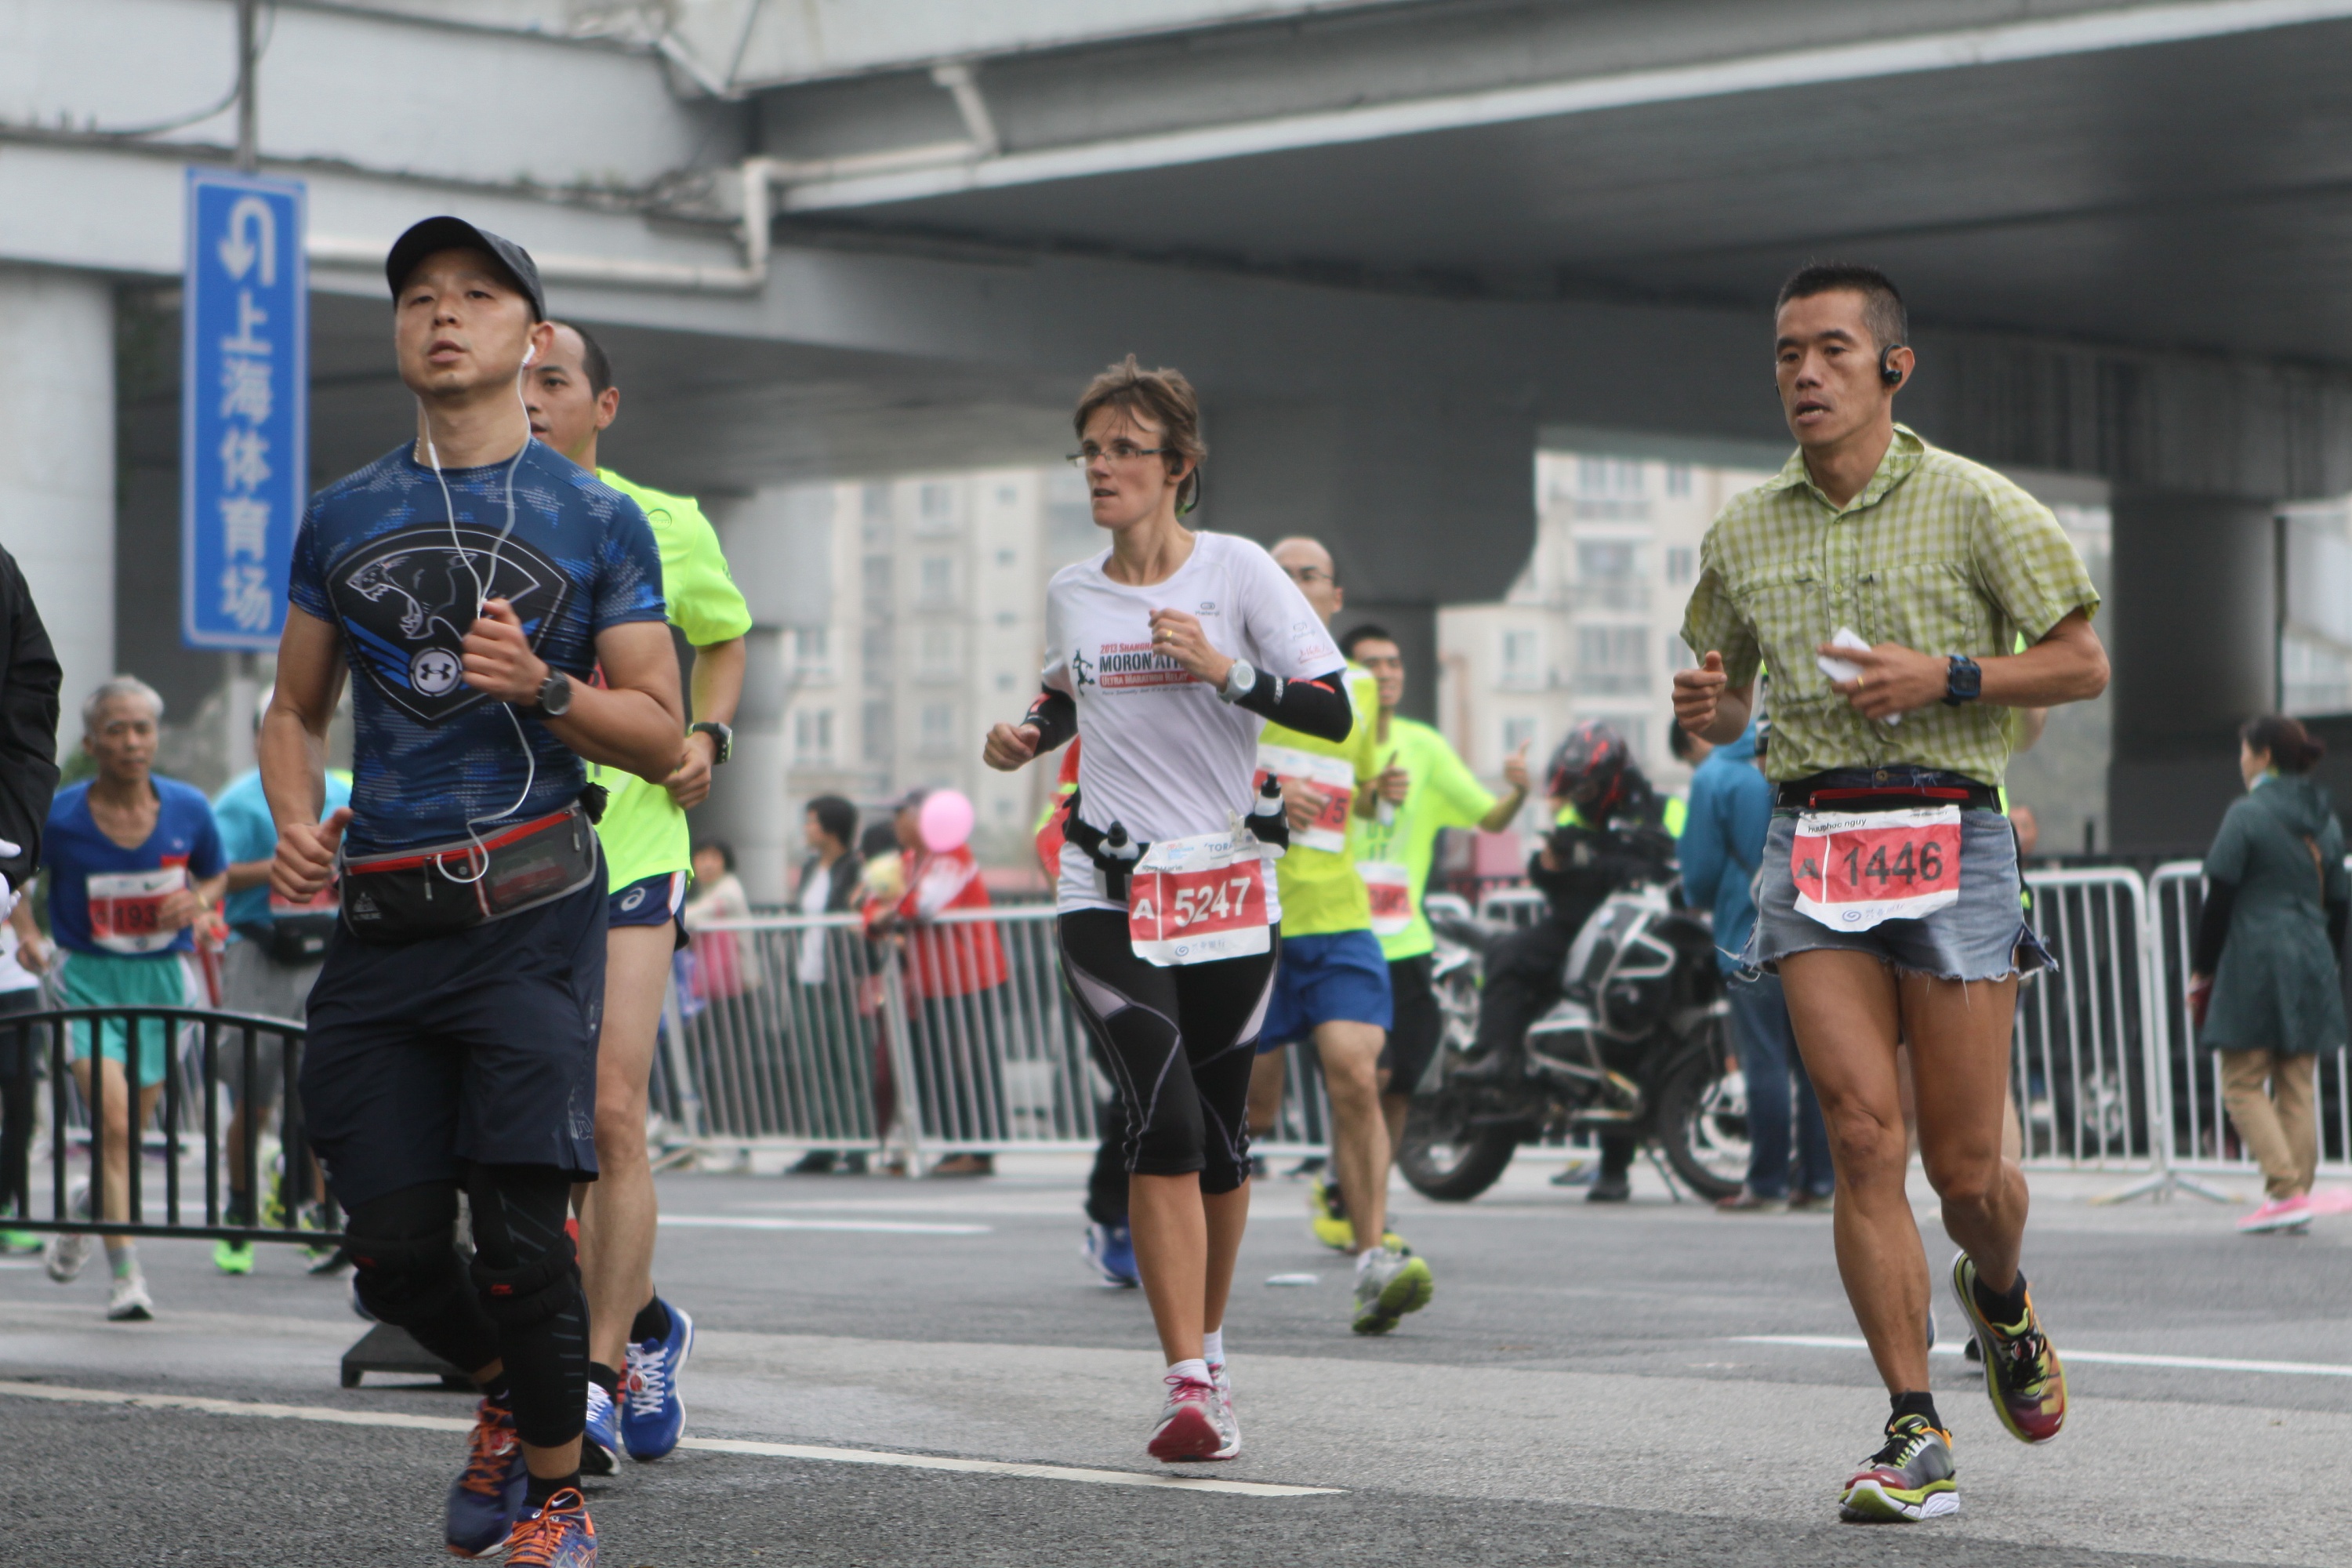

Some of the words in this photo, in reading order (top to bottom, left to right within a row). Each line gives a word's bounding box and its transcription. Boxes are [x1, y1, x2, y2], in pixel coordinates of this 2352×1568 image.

[219, 288, 274, 630] 上海体育场
[1100, 644, 1118, 654] 2013
[1795, 858, 1820, 879] A
[1843, 841, 1943, 886] 1446
[1132, 898, 1155, 920] A
[1174, 877, 1251, 927] 5247
